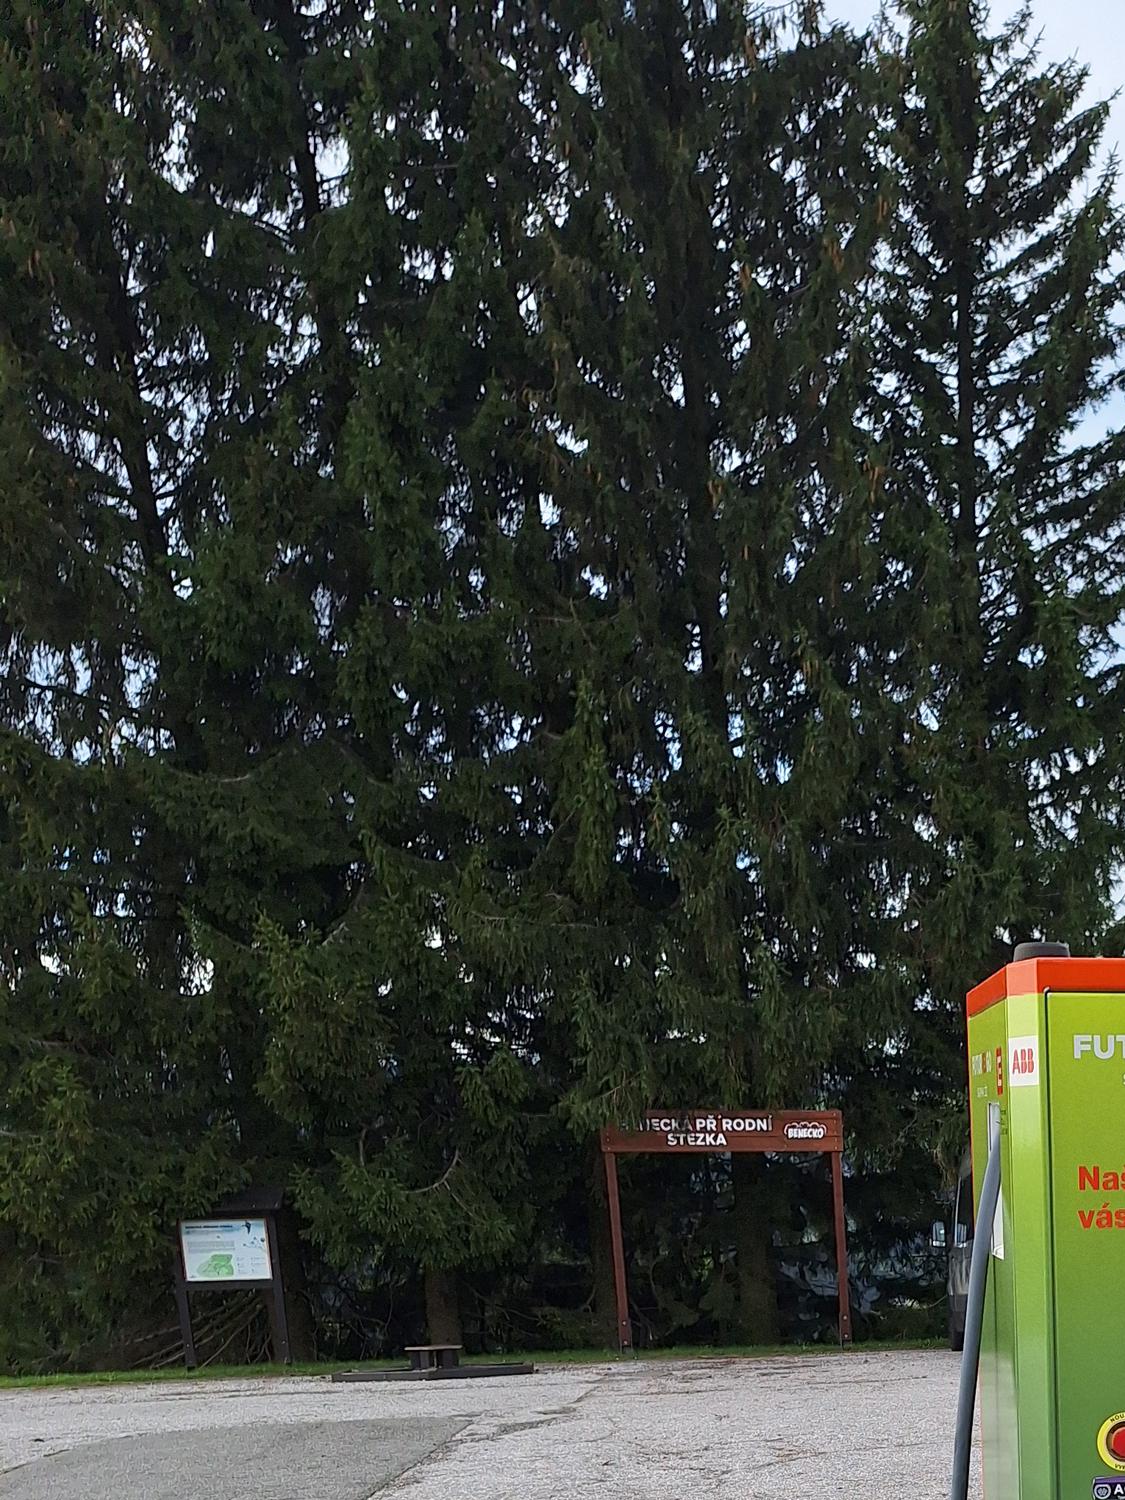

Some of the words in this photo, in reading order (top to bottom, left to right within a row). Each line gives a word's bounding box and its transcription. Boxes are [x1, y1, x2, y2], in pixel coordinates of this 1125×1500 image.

[1012, 1048, 1035, 1074] ABB
[667, 1132, 728, 1146] STEZKA
[788, 1128, 824, 1139] BENECKO
